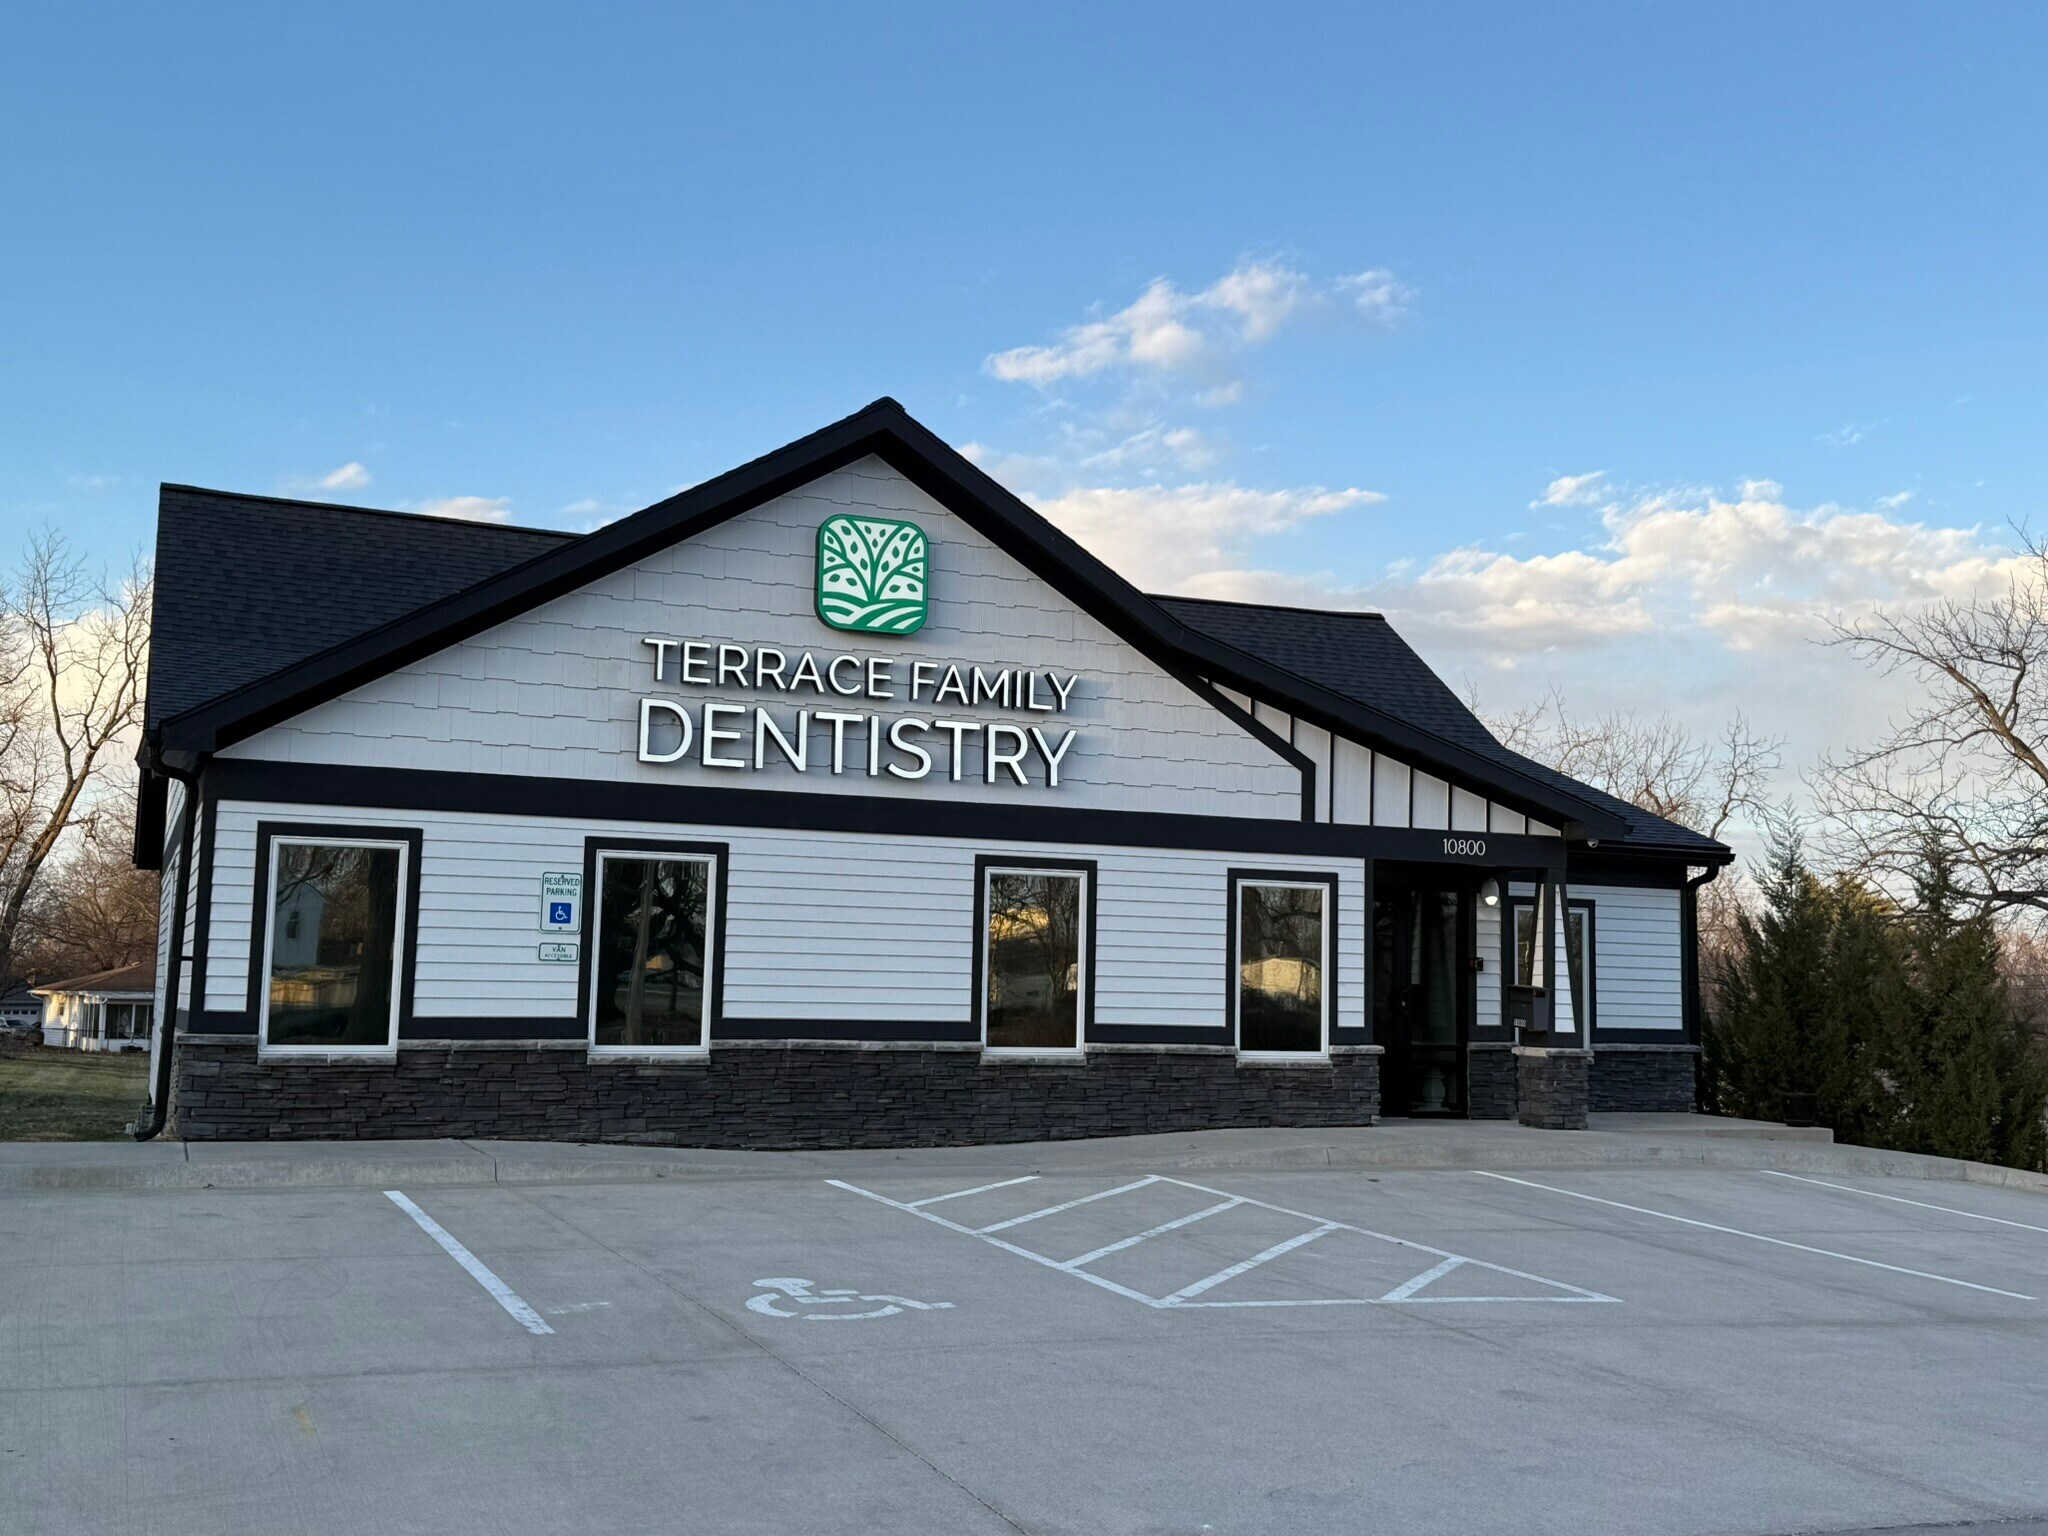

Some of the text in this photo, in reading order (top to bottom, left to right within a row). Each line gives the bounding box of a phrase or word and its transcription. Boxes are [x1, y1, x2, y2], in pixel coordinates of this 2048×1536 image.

[642, 637, 1079, 712] TERRACE FAMILY
[637, 698, 1078, 788] DENTISTRY
[1443, 838, 1486, 856] 10800
[544, 876, 580, 886] RESERVED
[546, 887, 577, 896] PARKING
